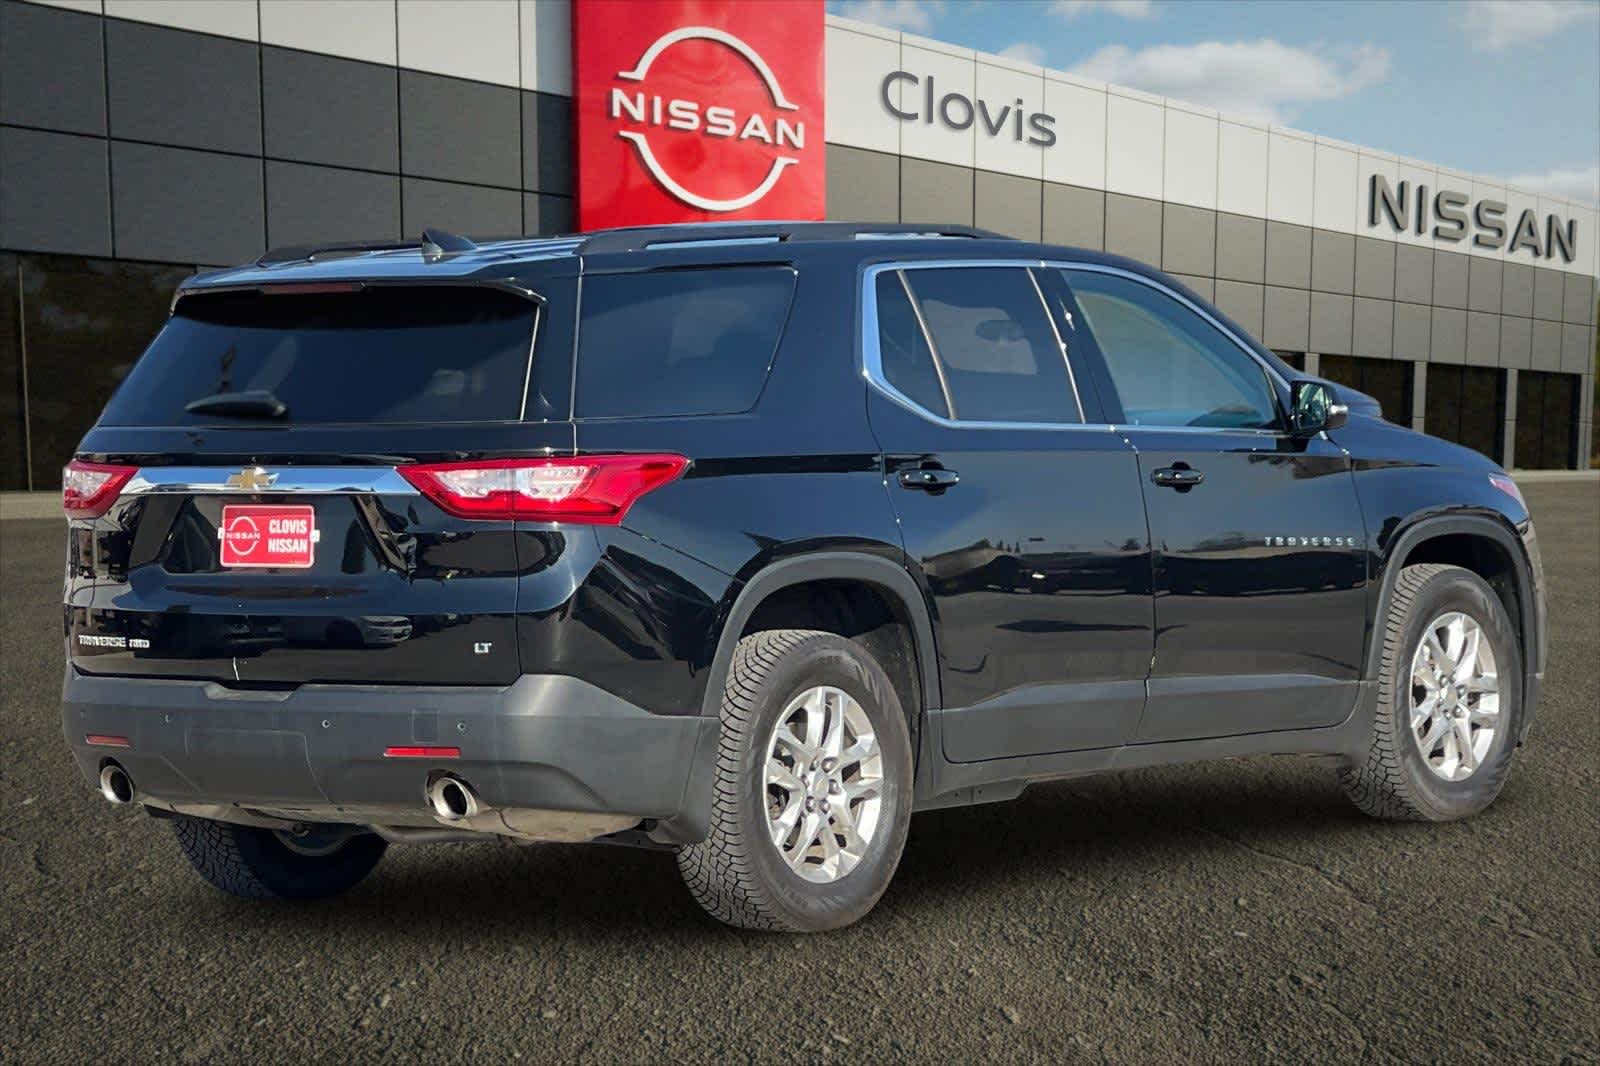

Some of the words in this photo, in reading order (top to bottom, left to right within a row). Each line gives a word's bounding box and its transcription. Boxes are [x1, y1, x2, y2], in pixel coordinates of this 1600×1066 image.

[881, 70, 1057, 147] Clovis
[611, 87, 805, 150] NISSAN
[1368, 173, 1578, 263] NISSAN
[268, 519, 307, 534] CLOVIS
[226, 531, 261, 540] NISSAN
[268, 538, 308, 553] NISSAN
[473, 642, 493, 654] LT
